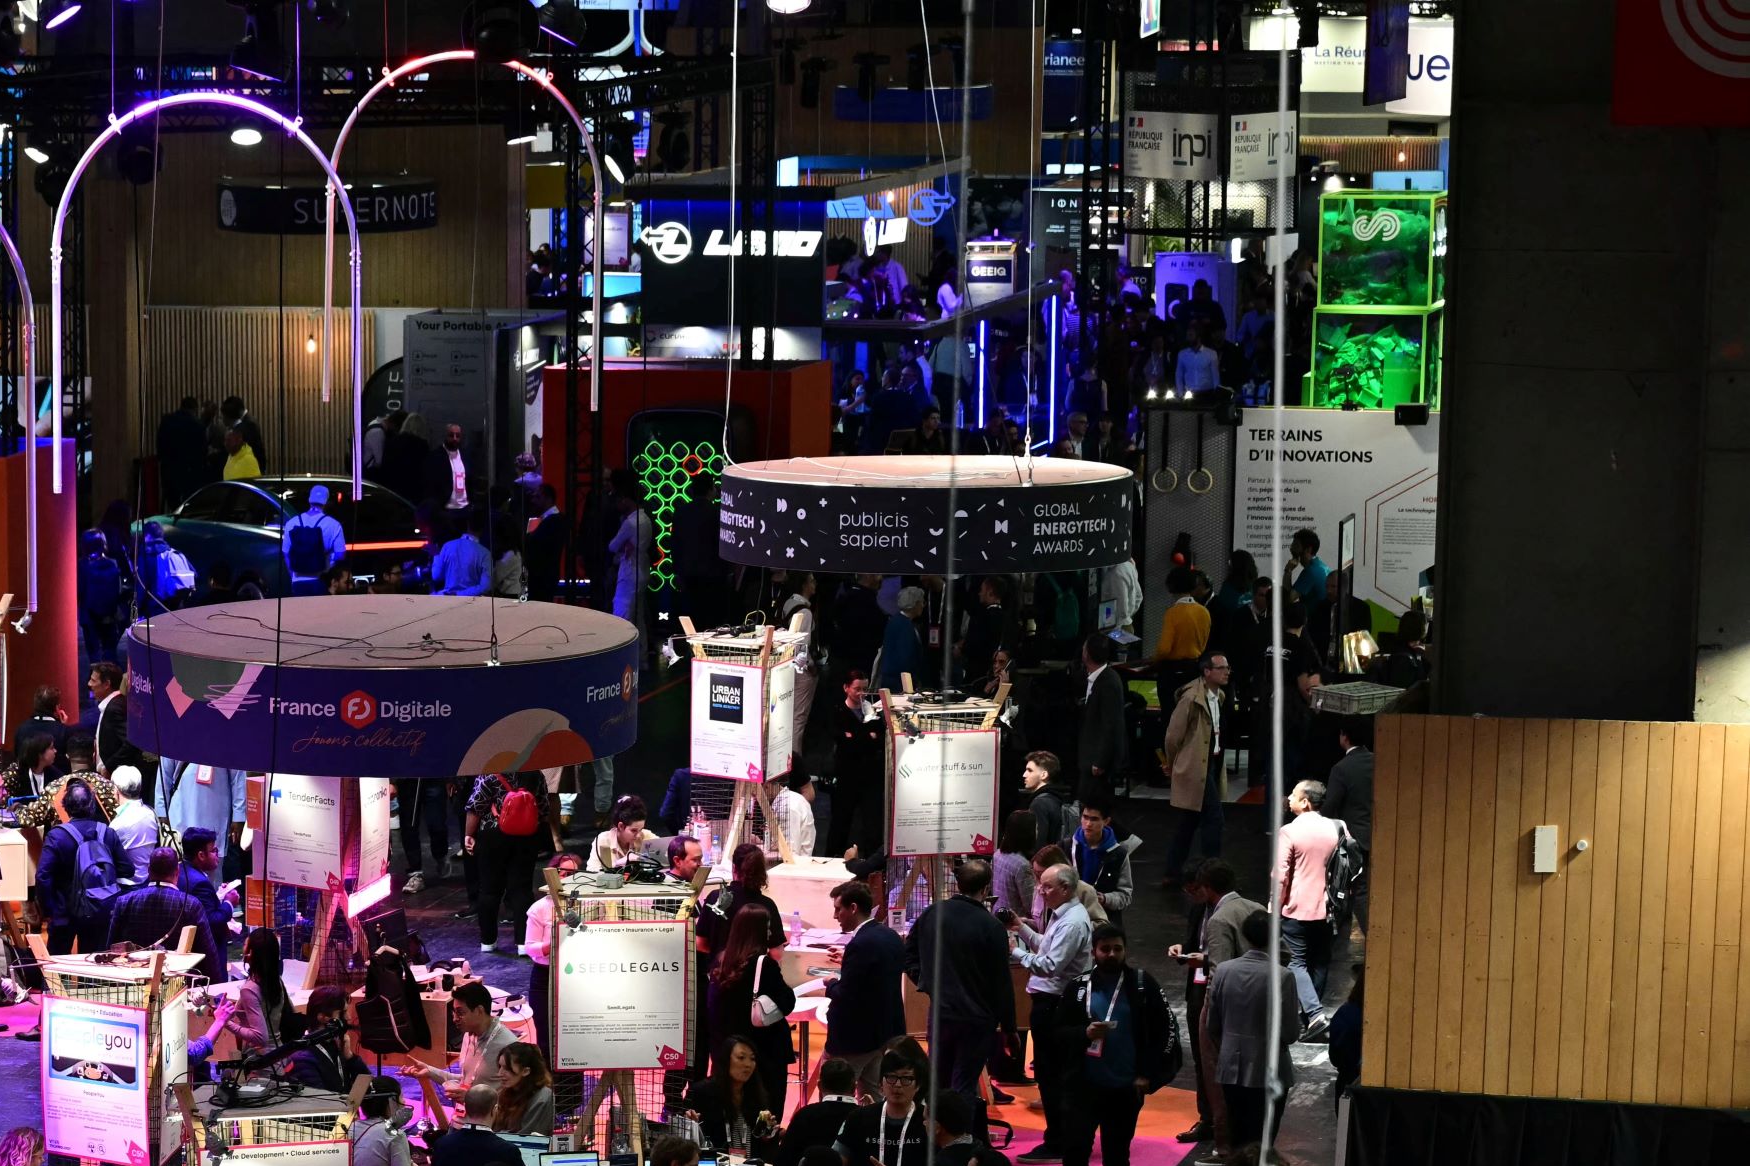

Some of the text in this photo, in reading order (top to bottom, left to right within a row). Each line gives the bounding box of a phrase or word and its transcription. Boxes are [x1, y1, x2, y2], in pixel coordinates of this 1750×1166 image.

[1128, 130, 1163, 141] RÉPUBLIQUE
[1234, 133, 1261, 144] RÉPUBLIQUE
[1128, 141, 1161, 152] FRANÇAISE
[1172, 128, 1212, 166] inpi
[1234, 144, 1260, 154] FRANÇAISE
[416, 321, 440, 331] Your
[443, 321, 492, 332] Portable
[1033, 502, 1081, 517] GLOBAL
[839, 511, 910, 530] publicis
[1033, 518, 1107, 536] ENERGYTECH
[839, 532, 909, 551] sapient
[1033, 539, 1084, 555] AWARDS
[587, 682, 621, 703] France
[712, 684, 741, 697] URBAN
[712, 693, 741, 705] LINKER
[269, 697, 453, 722] France Digitale
[961, 762, 967, 770] &
[288, 791, 336, 806] TenderFacts
[659, 926, 675, 934] Legal
[578, 961, 680, 973] SEEDLEGALS
[240, 1150, 285, 1161] Development
[290, 1149, 311, 1158] Cloud
[312, 1148, 340, 1156] services
